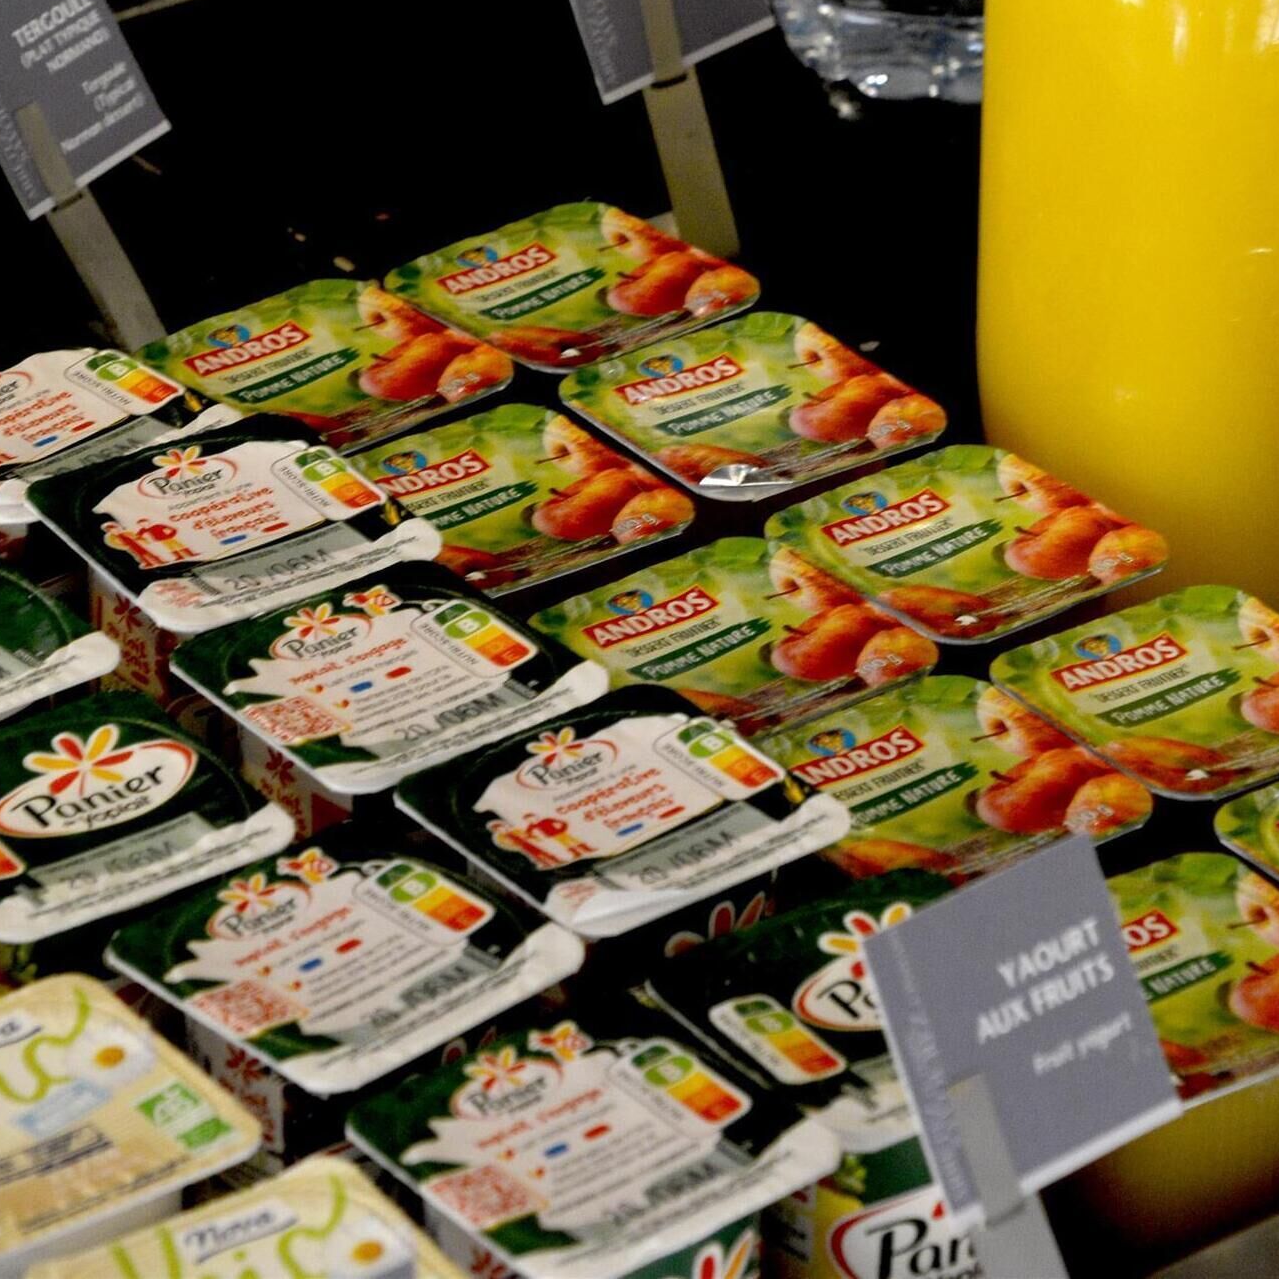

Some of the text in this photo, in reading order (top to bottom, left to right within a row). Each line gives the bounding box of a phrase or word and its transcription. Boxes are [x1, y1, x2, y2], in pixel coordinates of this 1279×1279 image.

[443, 245, 552, 294] ANDROS
[194, 325, 304, 375] ANDROS
[624, 357, 739, 405] ANDROS
[145, 468, 224, 497] Panier
[378, 453, 487, 496] NDROS
[169, 487, 275, 524] coopérative
[830, 493, 943, 544] ANDROS
[281, 625, 361, 660] Panier
[592, 590, 712, 646] ANDROS
[1061, 638, 1180, 689] ANDROS
[1167, 674, 1227, 709] NATURE
[527, 750, 605, 786] Panier
[793, 730, 915, 785] NDROS
[9, 762, 166, 830] Panier
[903, 769, 963, 808] NATURE
[997, 916, 1101, 989] YAOURT
[977, 999, 1032, 1045] AUX
[1029, 952, 1116, 1016] FRUITS
